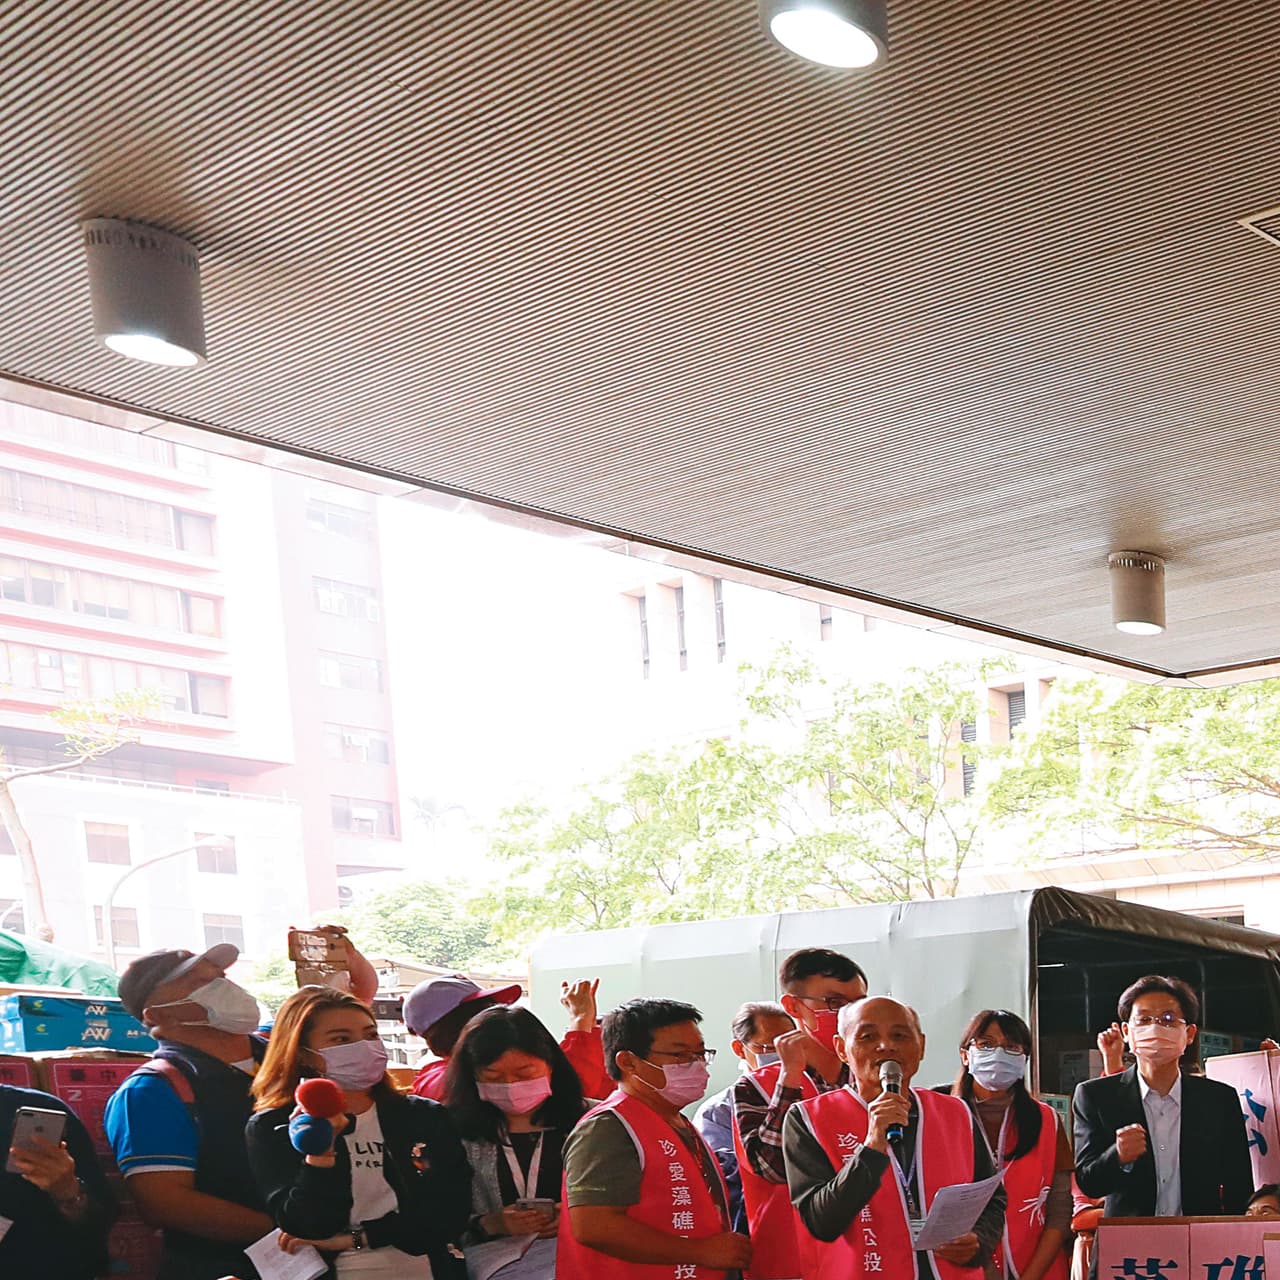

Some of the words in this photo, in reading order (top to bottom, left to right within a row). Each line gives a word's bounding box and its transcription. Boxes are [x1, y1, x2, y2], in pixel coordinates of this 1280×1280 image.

[658, 1139, 696, 1279] 珍愛藻礁投
